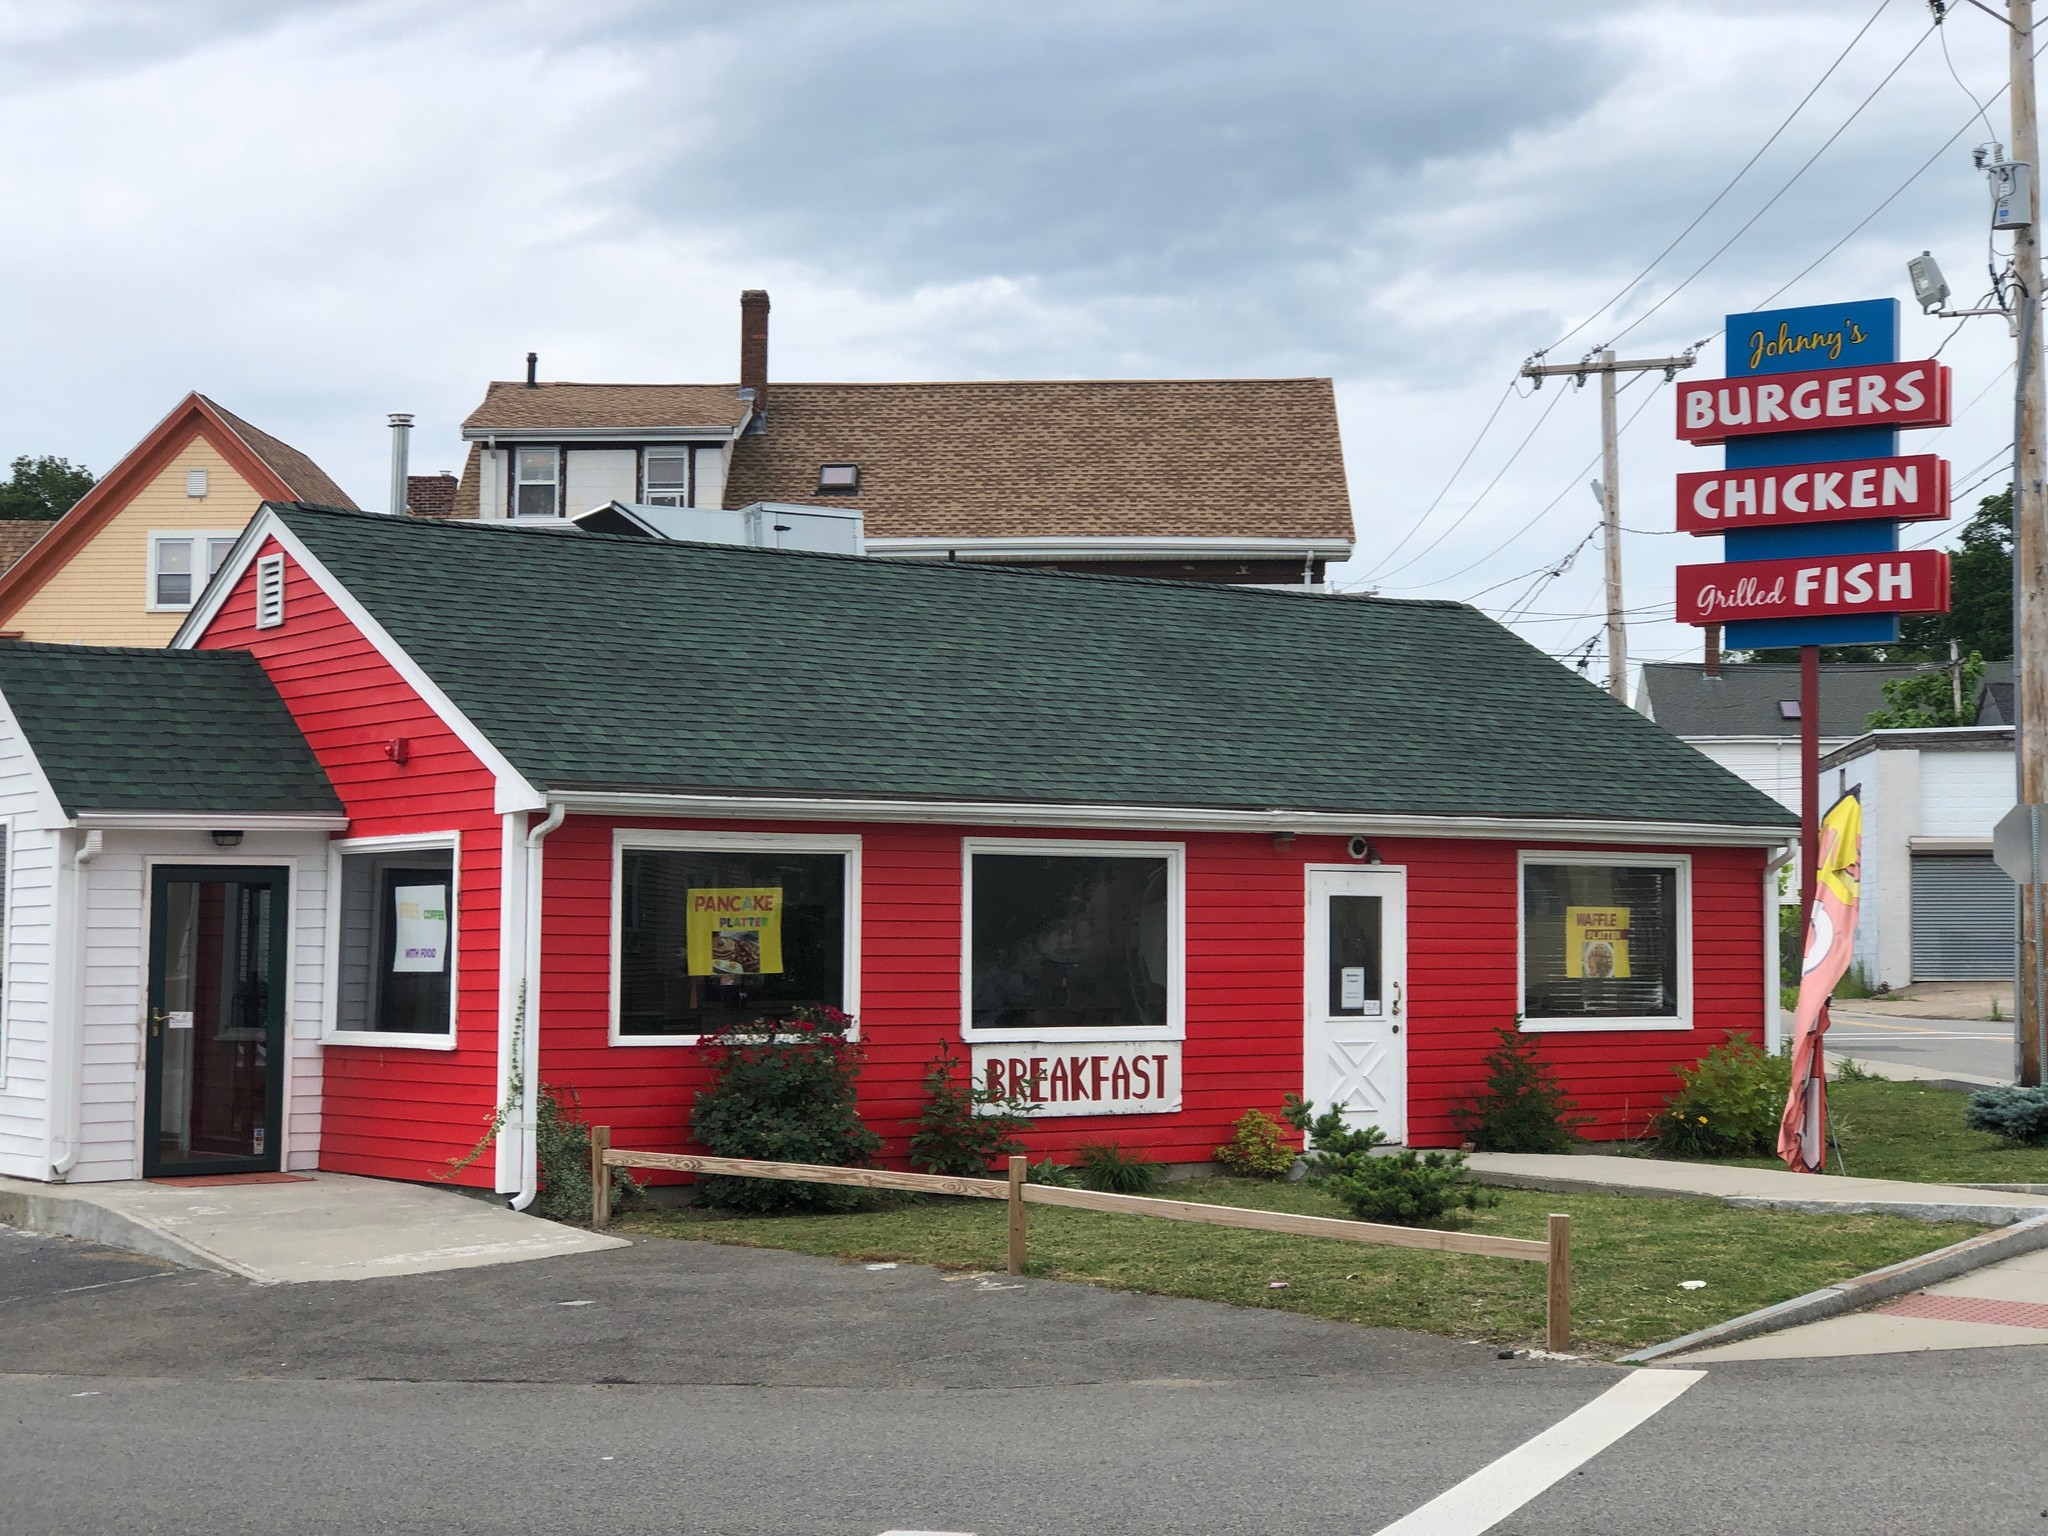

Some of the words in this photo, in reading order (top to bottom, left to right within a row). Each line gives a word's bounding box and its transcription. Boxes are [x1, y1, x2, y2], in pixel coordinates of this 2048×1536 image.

[1749, 319, 1868, 370] Johnny's
[1685, 369, 1926, 429] BURGERS
[1693, 465, 1919, 519] CHICKEN
[1697, 576, 1787, 616] Grilled
[1794, 562, 1913, 606] FISH
[694, 895, 773, 912] PANCAKE
[720, 917, 768, 928] PLATTER
[1577, 913, 1616, 926] WAFFLE
[420, 948, 436, 958] FOOD
[986, 1055, 1169, 1103] BREAKFAST
